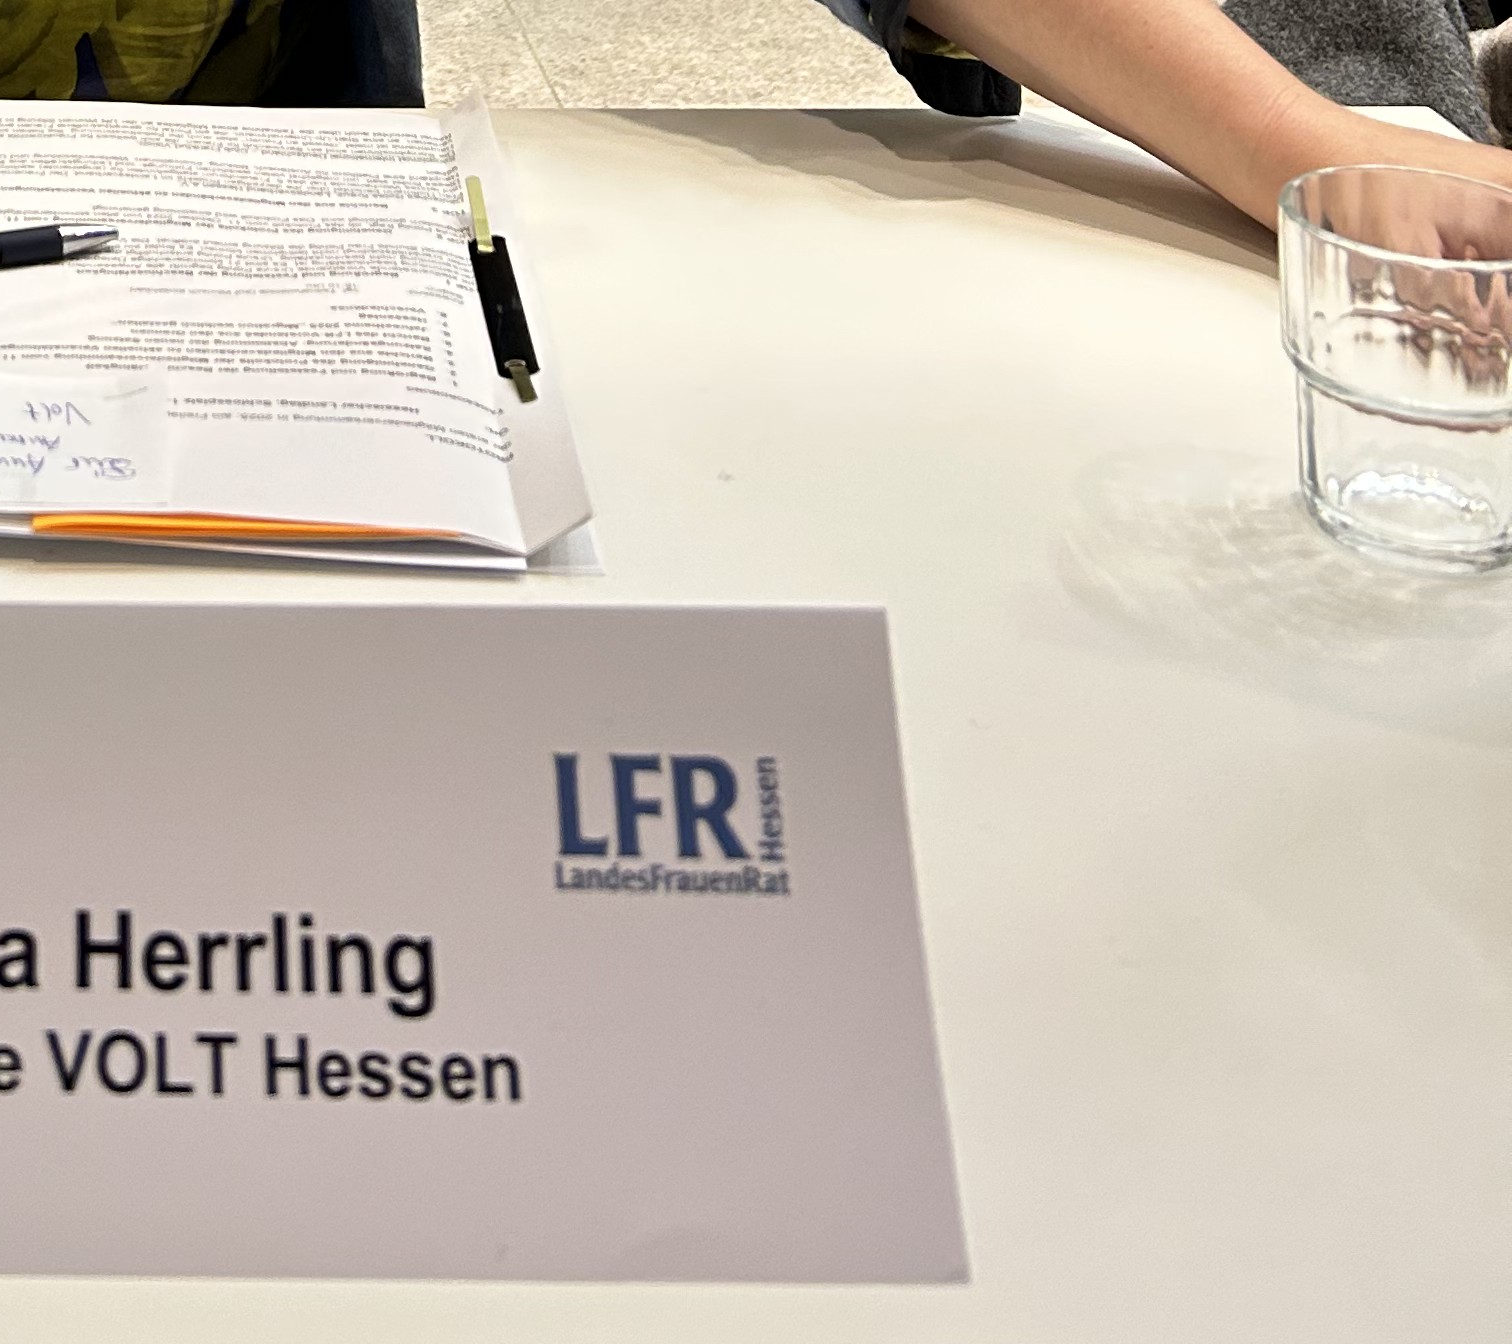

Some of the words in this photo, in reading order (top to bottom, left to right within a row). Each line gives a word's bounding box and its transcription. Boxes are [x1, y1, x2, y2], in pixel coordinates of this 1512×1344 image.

[553, 752, 751, 859] LFR
[756, 756, 784, 861] Hessen
[554, 861, 790, 895] LandesFrauenRat
[74, 909, 436, 1018] Herrling
[46, 1029, 238, 1096] VOLT
[264, 1035, 522, 1103] Hessen
